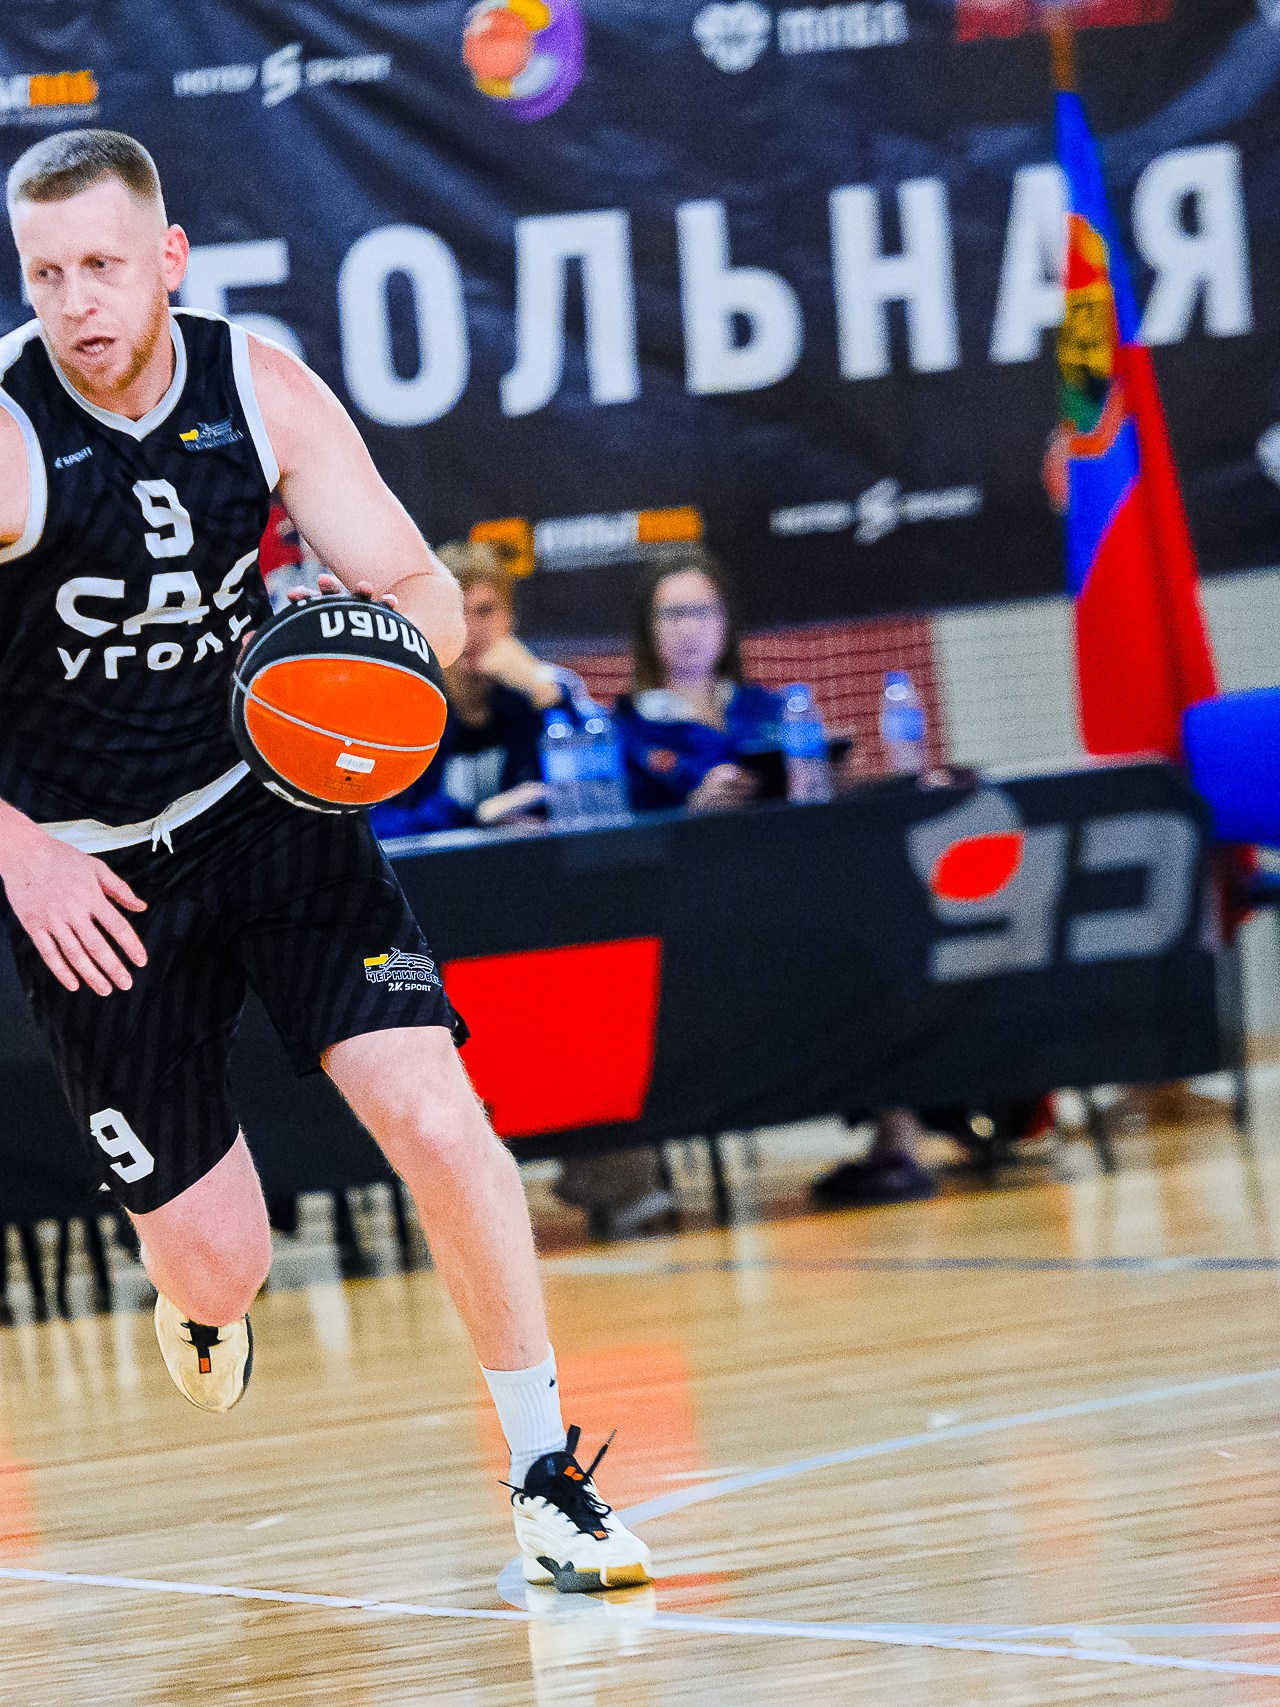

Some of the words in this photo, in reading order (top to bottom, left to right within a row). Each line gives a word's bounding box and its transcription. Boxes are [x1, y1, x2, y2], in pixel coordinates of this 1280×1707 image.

[131, 478, 195, 559] 9
[405, 982, 432, 992] SPORT
[89, 1107, 155, 1184] 9
